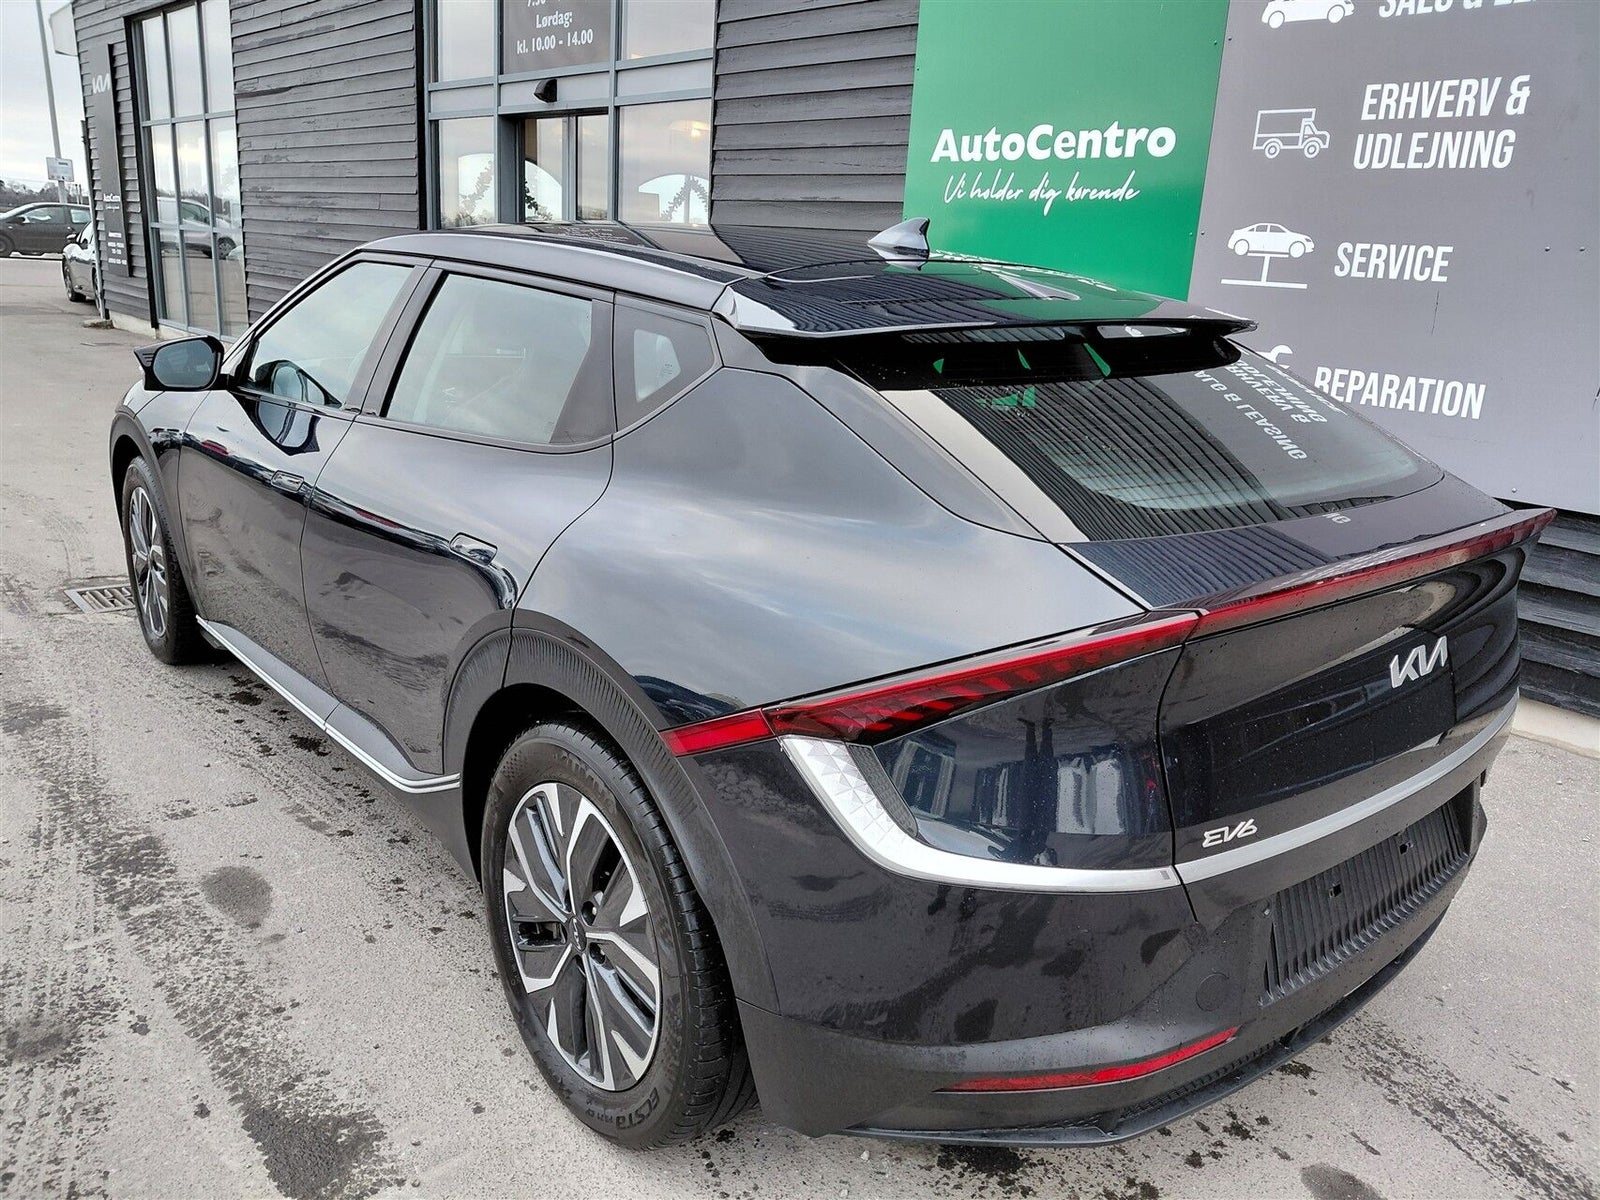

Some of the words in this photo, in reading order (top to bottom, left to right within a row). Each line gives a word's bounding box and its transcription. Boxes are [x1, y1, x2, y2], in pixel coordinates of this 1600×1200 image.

[536, 11, 573, 28] Lørdag:
[516, 39, 528, 55] kl.
[532, 35, 556, 52] 10.00
[567, 29, 594, 47] 14.00
[1361, 77, 1502, 121] ERHVERV
[1505, 75, 1531, 116] &
[930, 121, 1177, 163] AutoCentro
[1353, 129, 1516, 170] UDLEJNING
[944, 172, 967, 204] Vi
[969, 168, 1024, 202] holder
[1028, 171, 1062, 217] dig
[1065, 169, 1140, 202] kørende
[1334, 242, 1454, 282] SERVICE
[1314, 366, 1487, 420] REPARATION
[1389, 635, 1448, 689] KIA
[1202, 818, 1258, 848] EV6
